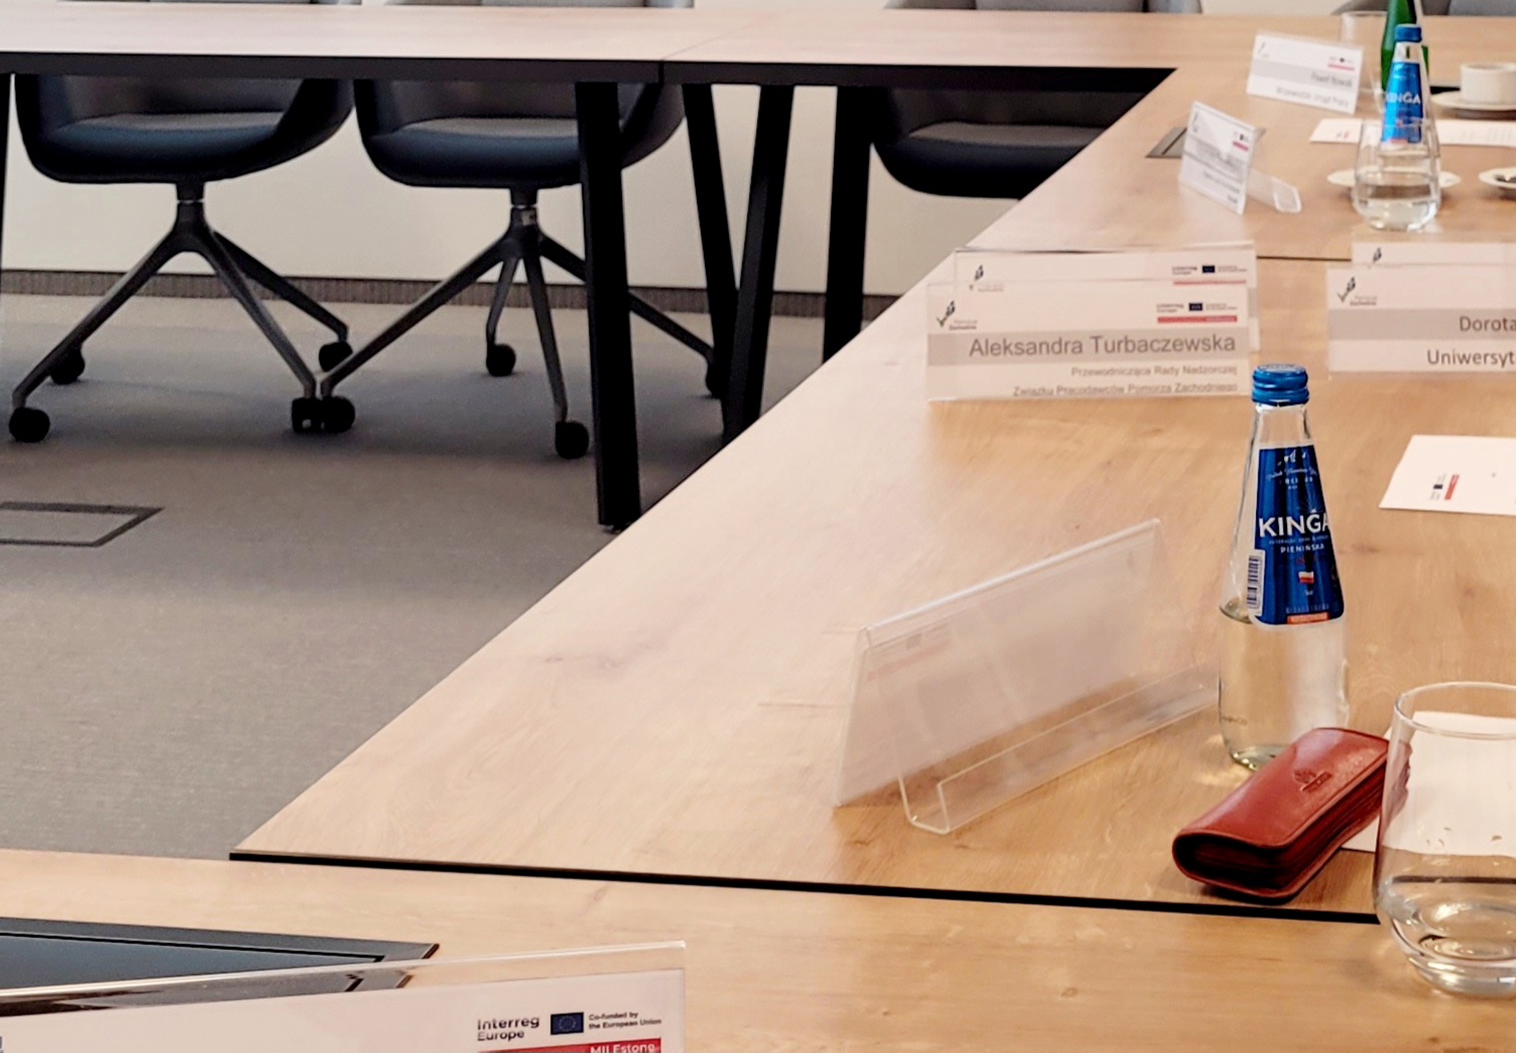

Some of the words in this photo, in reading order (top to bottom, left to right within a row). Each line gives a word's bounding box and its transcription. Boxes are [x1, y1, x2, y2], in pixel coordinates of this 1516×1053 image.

[968, 338, 1084, 357] Aleksandra
[1090, 334, 1237, 355] Turbaczewska
[588, 1011, 628, 1021] Co-funded
[630, 1011, 638, 1019] by
[477, 1017, 540, 1031] Interreg
[588, 1021, 601, 1030] the
[602, 1020, 638, 1029] European
[640, 1018, 662, 1026] Union
[477, 1030, 525, 1042] Europe
